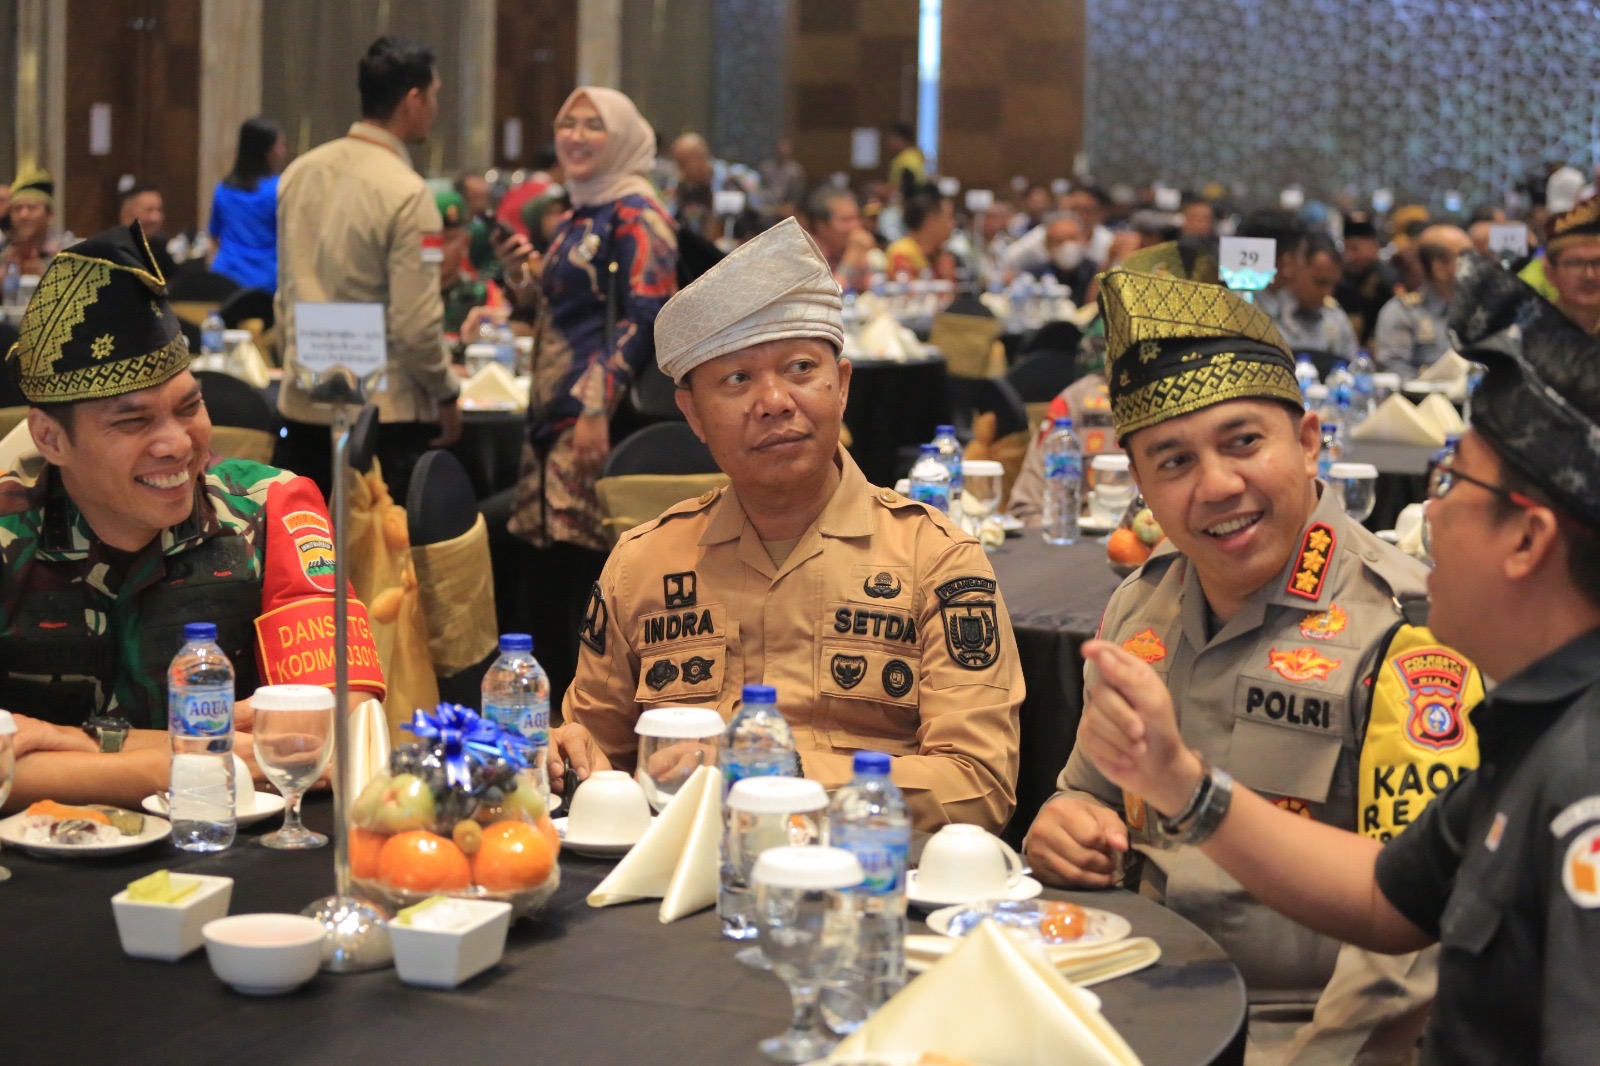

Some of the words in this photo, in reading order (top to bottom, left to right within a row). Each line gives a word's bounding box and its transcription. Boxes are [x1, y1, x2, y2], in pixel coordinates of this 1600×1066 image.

[1239, 250, 1259, 266] 29
[644, 609, 714, 644] INDRA
[834, 608, 917, 644] SETDA
[275, 645, 337, 684] KODIM
[1419, 676, 1452, 688] RIAU
[190, 700, 228, 718] AQUA
[1246, 687, 1330, 729] POLRI
[1374, 762, 1472, 800] KAO
